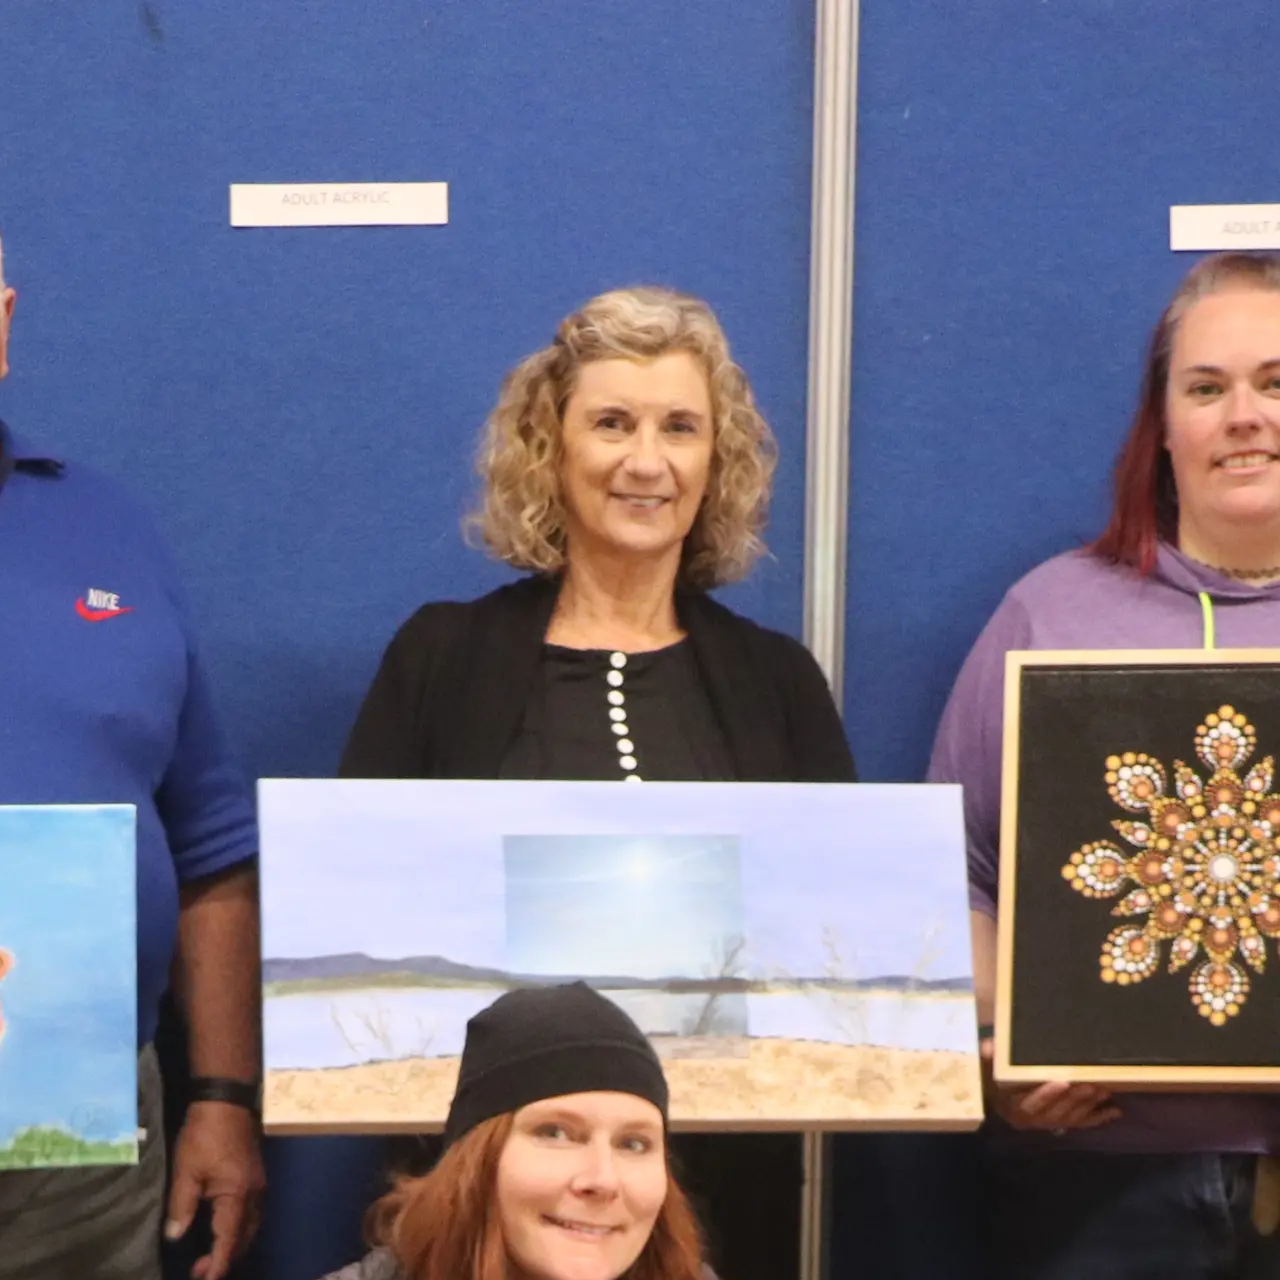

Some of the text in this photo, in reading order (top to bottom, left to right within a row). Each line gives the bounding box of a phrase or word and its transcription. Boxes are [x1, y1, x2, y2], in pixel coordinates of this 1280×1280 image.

[281, 190, 391, 206] ADULT ACRYLIC
[1221, 220, 1271, 235] ADULT
[87, 588, 120, 610] NIKE
